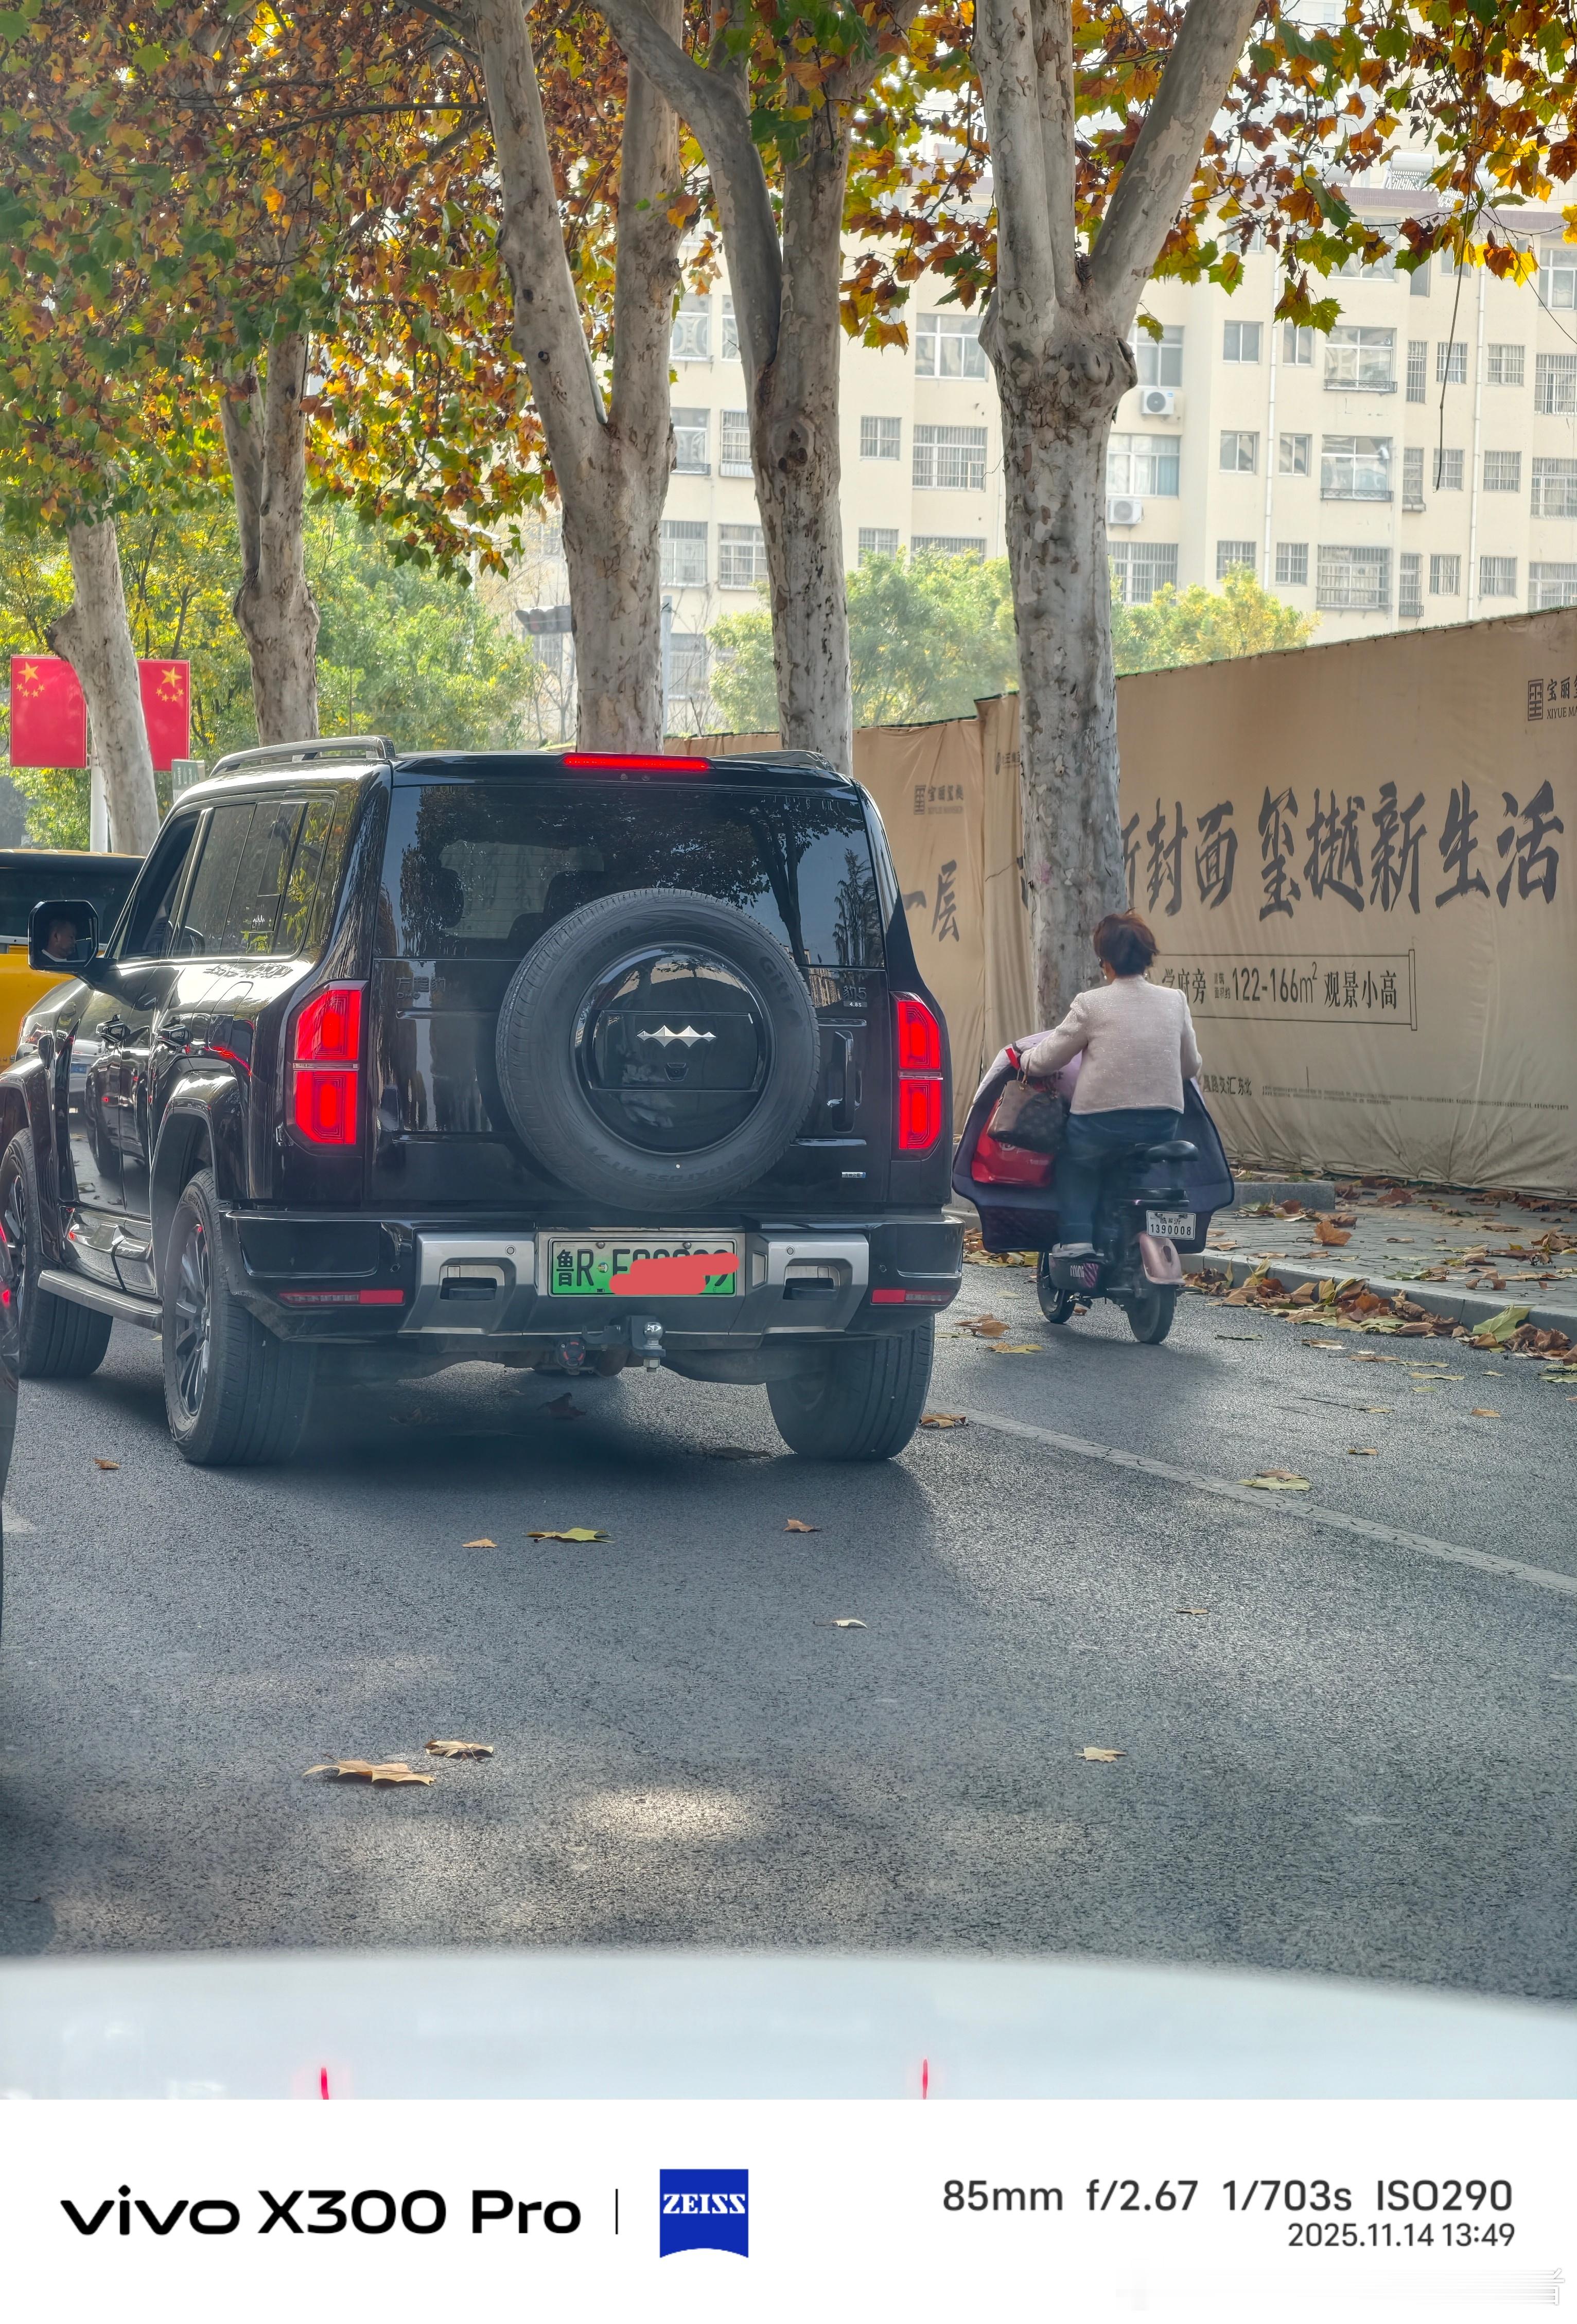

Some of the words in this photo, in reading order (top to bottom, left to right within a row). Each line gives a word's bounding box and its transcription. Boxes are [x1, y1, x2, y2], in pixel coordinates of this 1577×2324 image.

[1547, 708, 1567, 719] XIYUE
[1324, 970, 1397, 1010] 观景小高
[1151, 1224, 1191, 1236] 1390008
